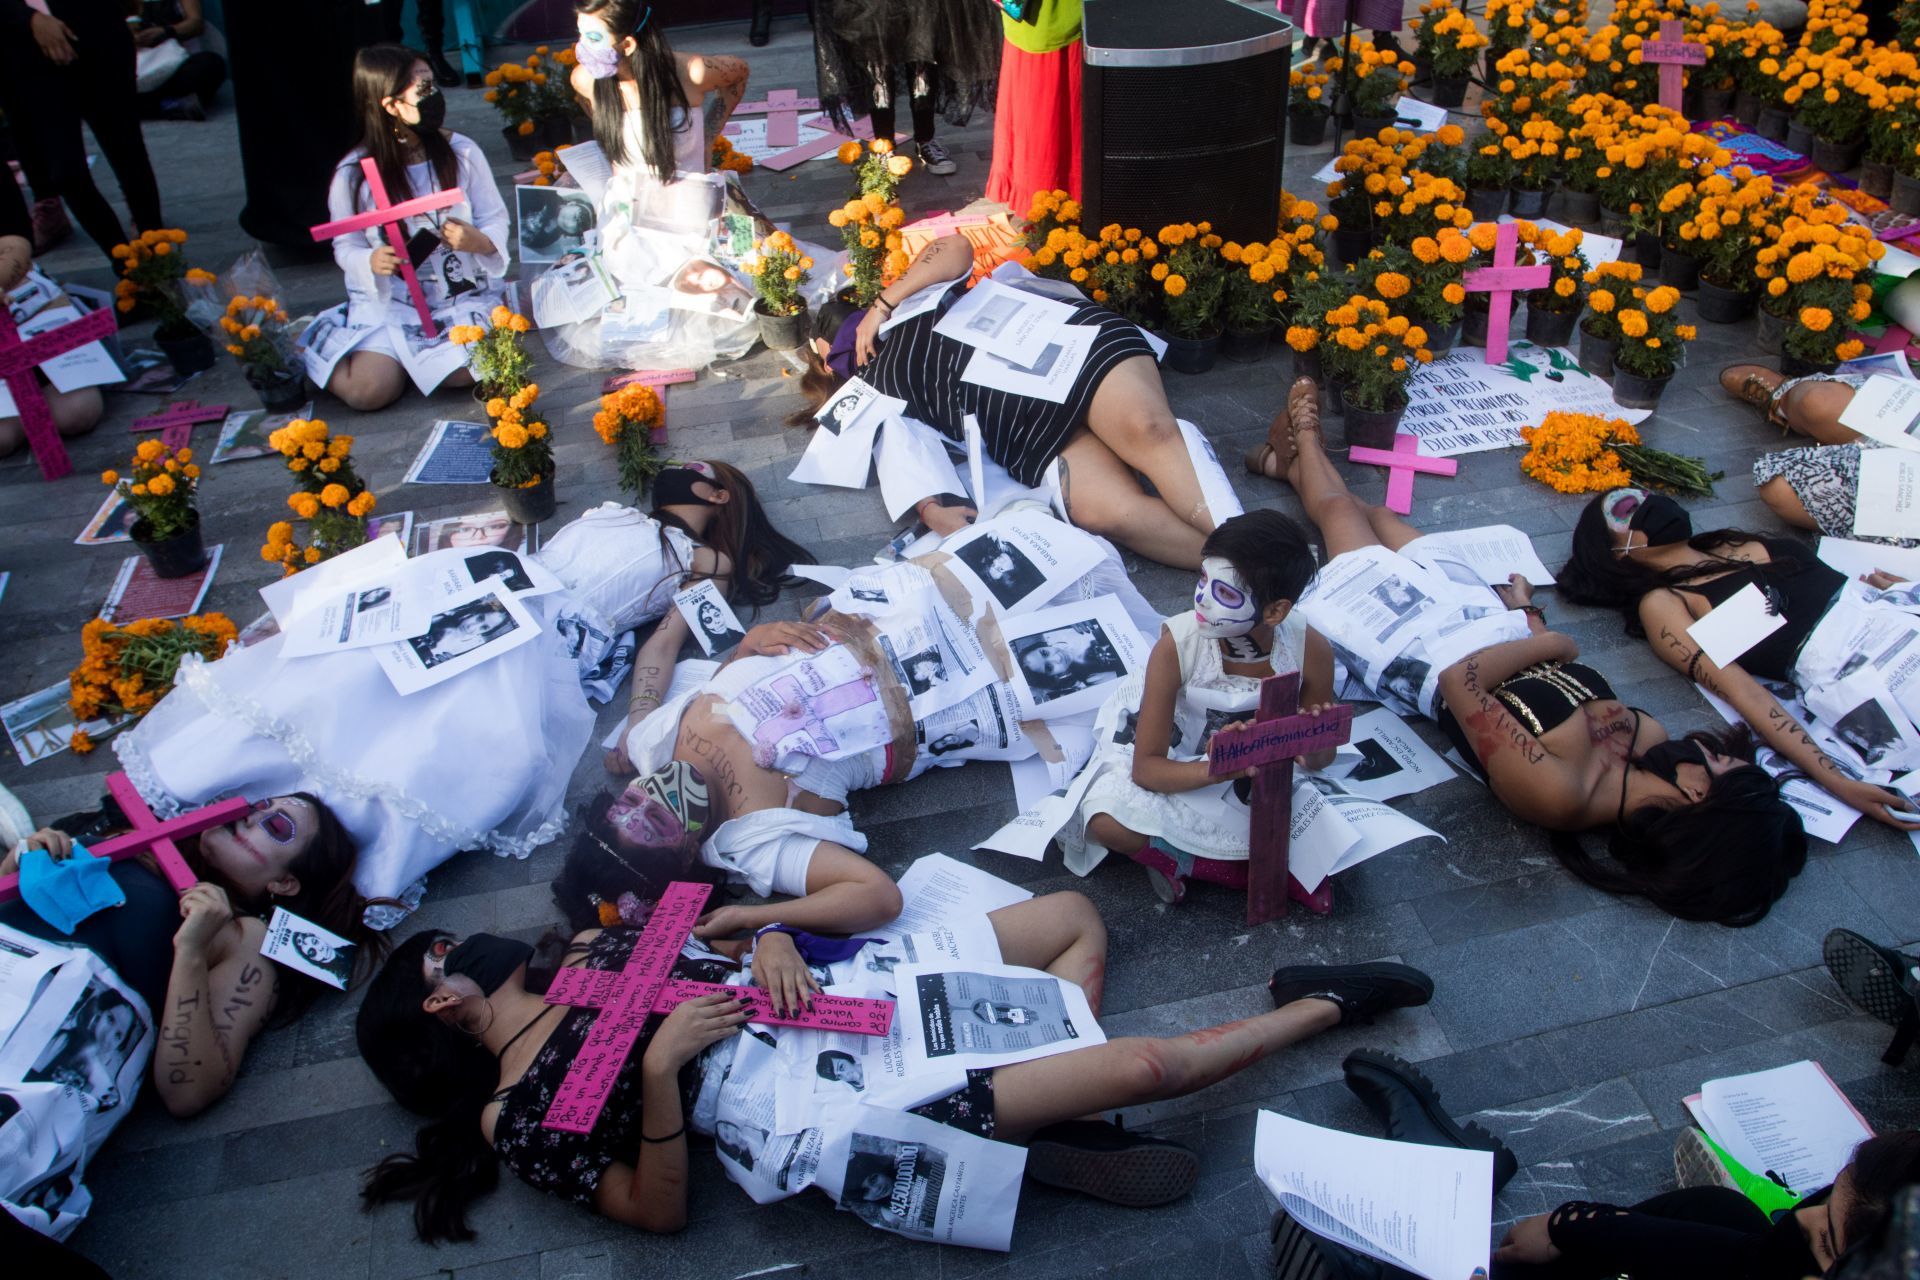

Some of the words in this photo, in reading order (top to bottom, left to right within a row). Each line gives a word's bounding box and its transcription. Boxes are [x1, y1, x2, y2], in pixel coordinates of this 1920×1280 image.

[1433, 379, 1492, 397] PROTESTA
[1451, 392, 1529, 410] PREGUNTAMOS
[1404, 420, 1446, 438] BIEN
[1458, 412, 1504, 427] NADIE
[1501, 409, 1529, 422] NOS
[1423, 435, 1457, 452] DIO
[1455, 432, 1485, 447] UNA
[1400, 752, 1423, 774] INGRID
[1290, 809, 1305, 830] UCIA
[1290, 819, 1311, 842] ROBLES
[600, 1008, 613, 1024] no
[873, 1001, 887, 1011] tu
[820, 1018, 863, 1028] camino
[871, 1022, 887, 1034] De
[162, 989, 201, 1086] Ingrid
[582, 1049, 606, 1083] mundo
